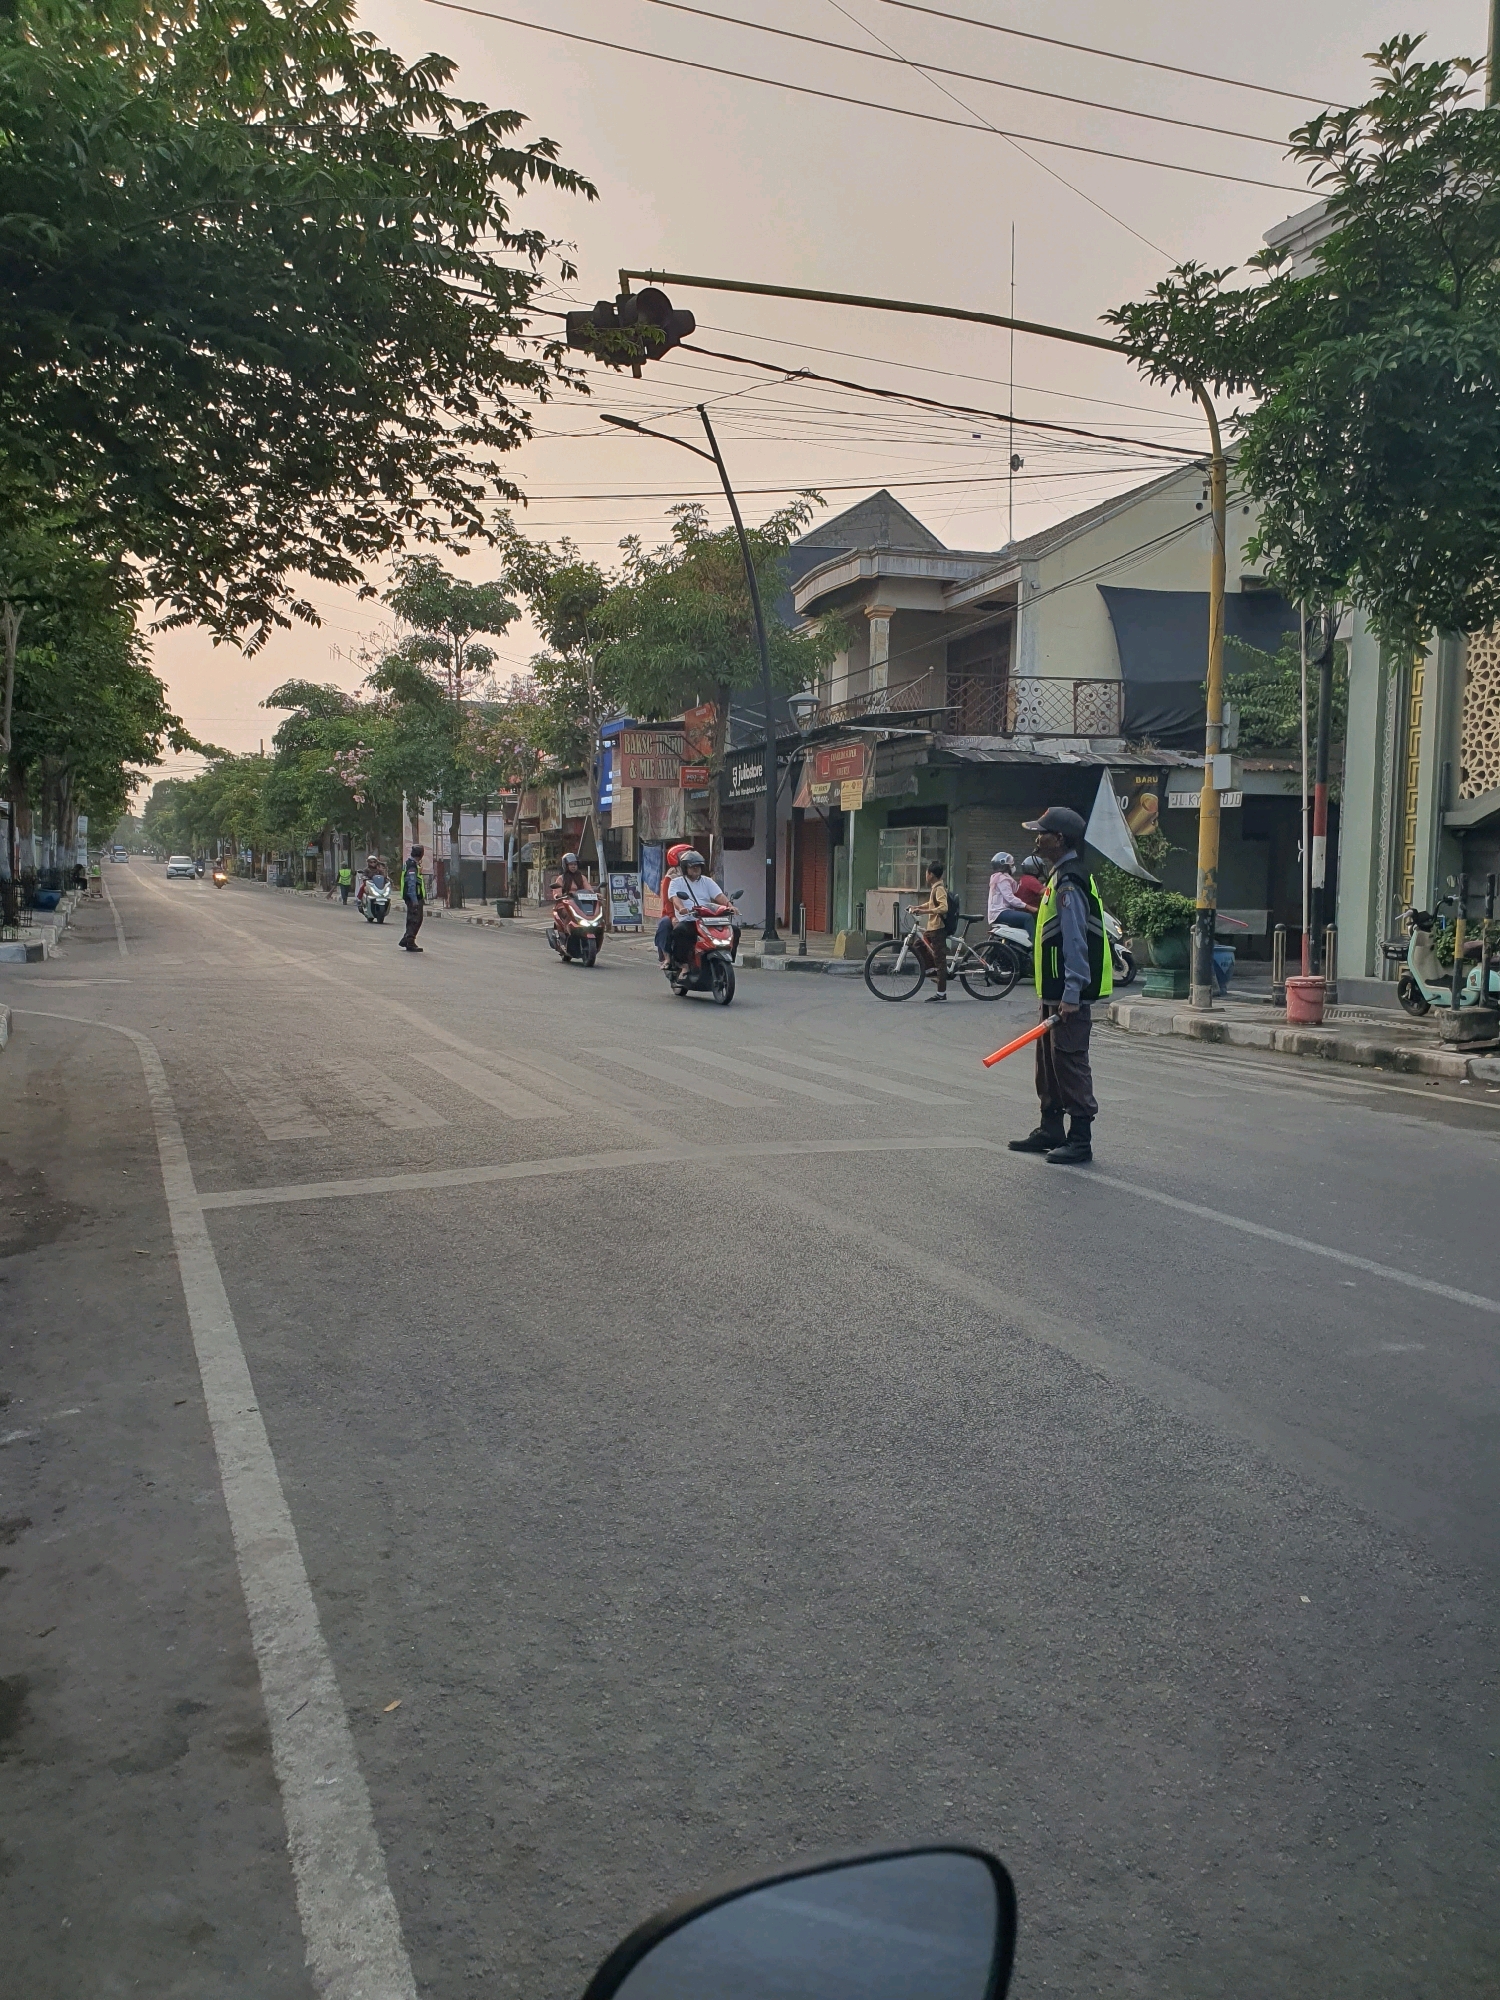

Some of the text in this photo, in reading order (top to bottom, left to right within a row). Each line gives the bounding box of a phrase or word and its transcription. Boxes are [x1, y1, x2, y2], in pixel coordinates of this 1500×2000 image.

[624, 733, 684, 757] BAKSO JUMBO
[629, 758, 680, 780] & MIE AYAM
[738, 762, 763, 787] juliostore
[1135, 776, 1159, 784] BARU
[1220, 794, 1242, 805] OJO
